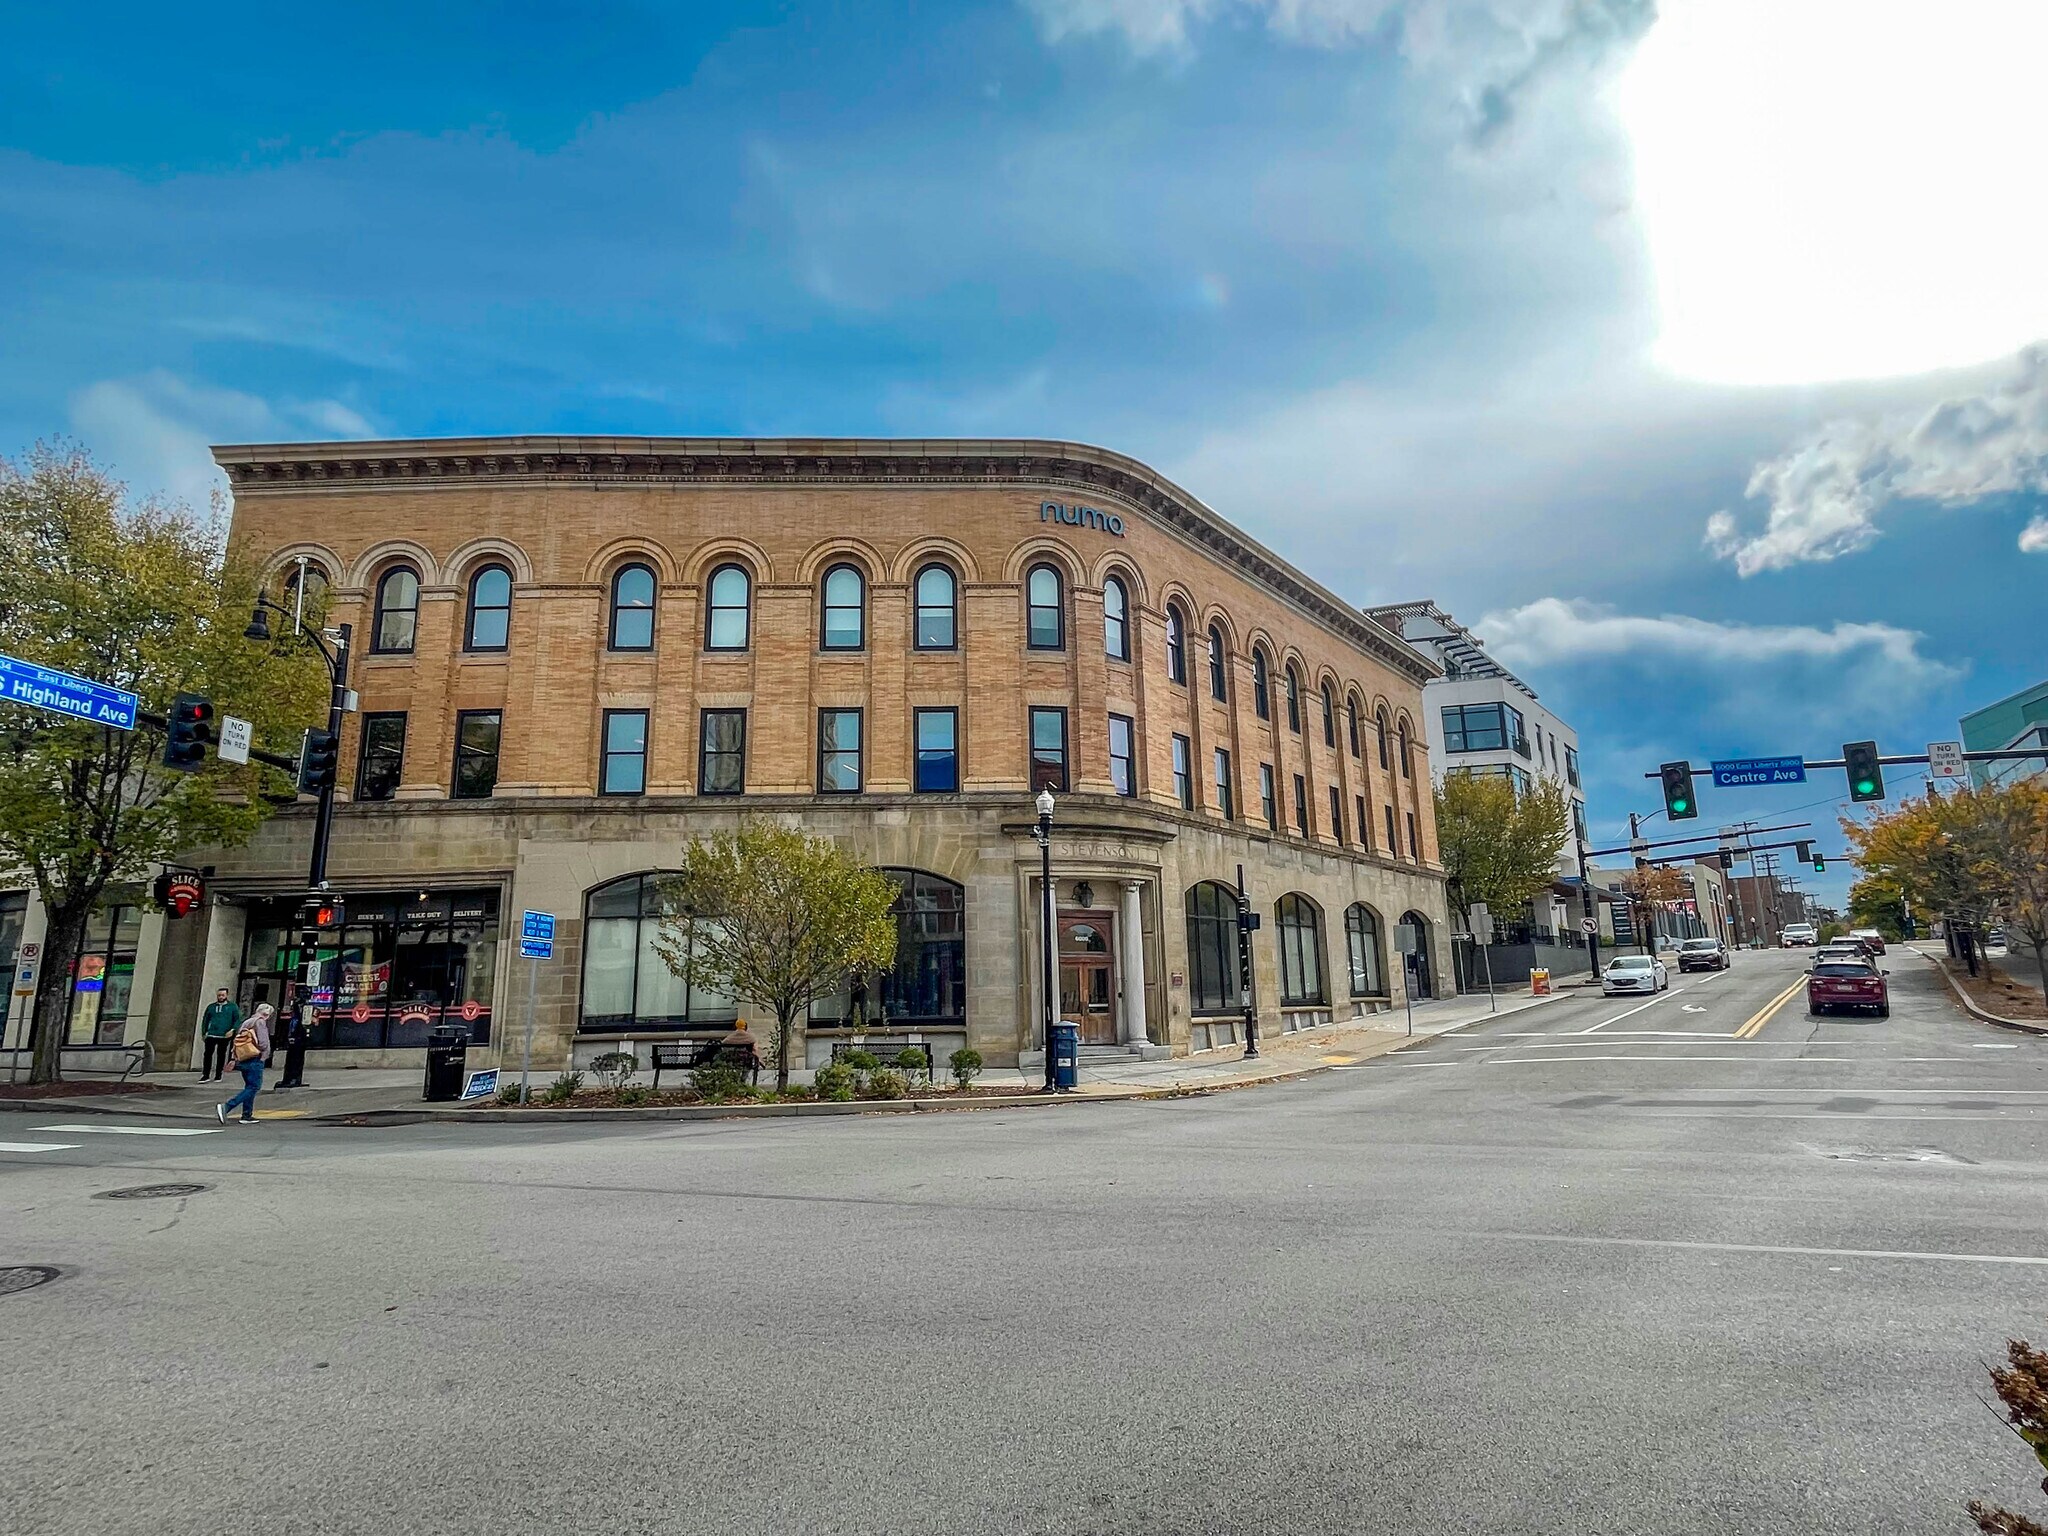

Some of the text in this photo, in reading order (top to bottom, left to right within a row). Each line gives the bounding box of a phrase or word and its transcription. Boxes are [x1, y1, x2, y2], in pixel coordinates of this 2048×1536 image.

[1041, 501, 1125, 537] numo
[37, 671, 59, 684] East
[62, 678, 94, 695] Liberty
[12, 679, 92, 714] Highland
[98, 704, 129, 723] Ave
[231, 721, 244, 731] NO
[228, 730, 245, 740] TURN
[222, 738, 247, 750] ON RED
[1753, 760, 1779, 770] Liberty
[1721, 769, 1798, 784] Centre Ave
[1061, 842, 1134, 859] STEVENSON
[171, 874, 201, 889] SLICE
[345, 973, 381, 982] CHEESE
[402, 1004, 429, 1015] SLICE
